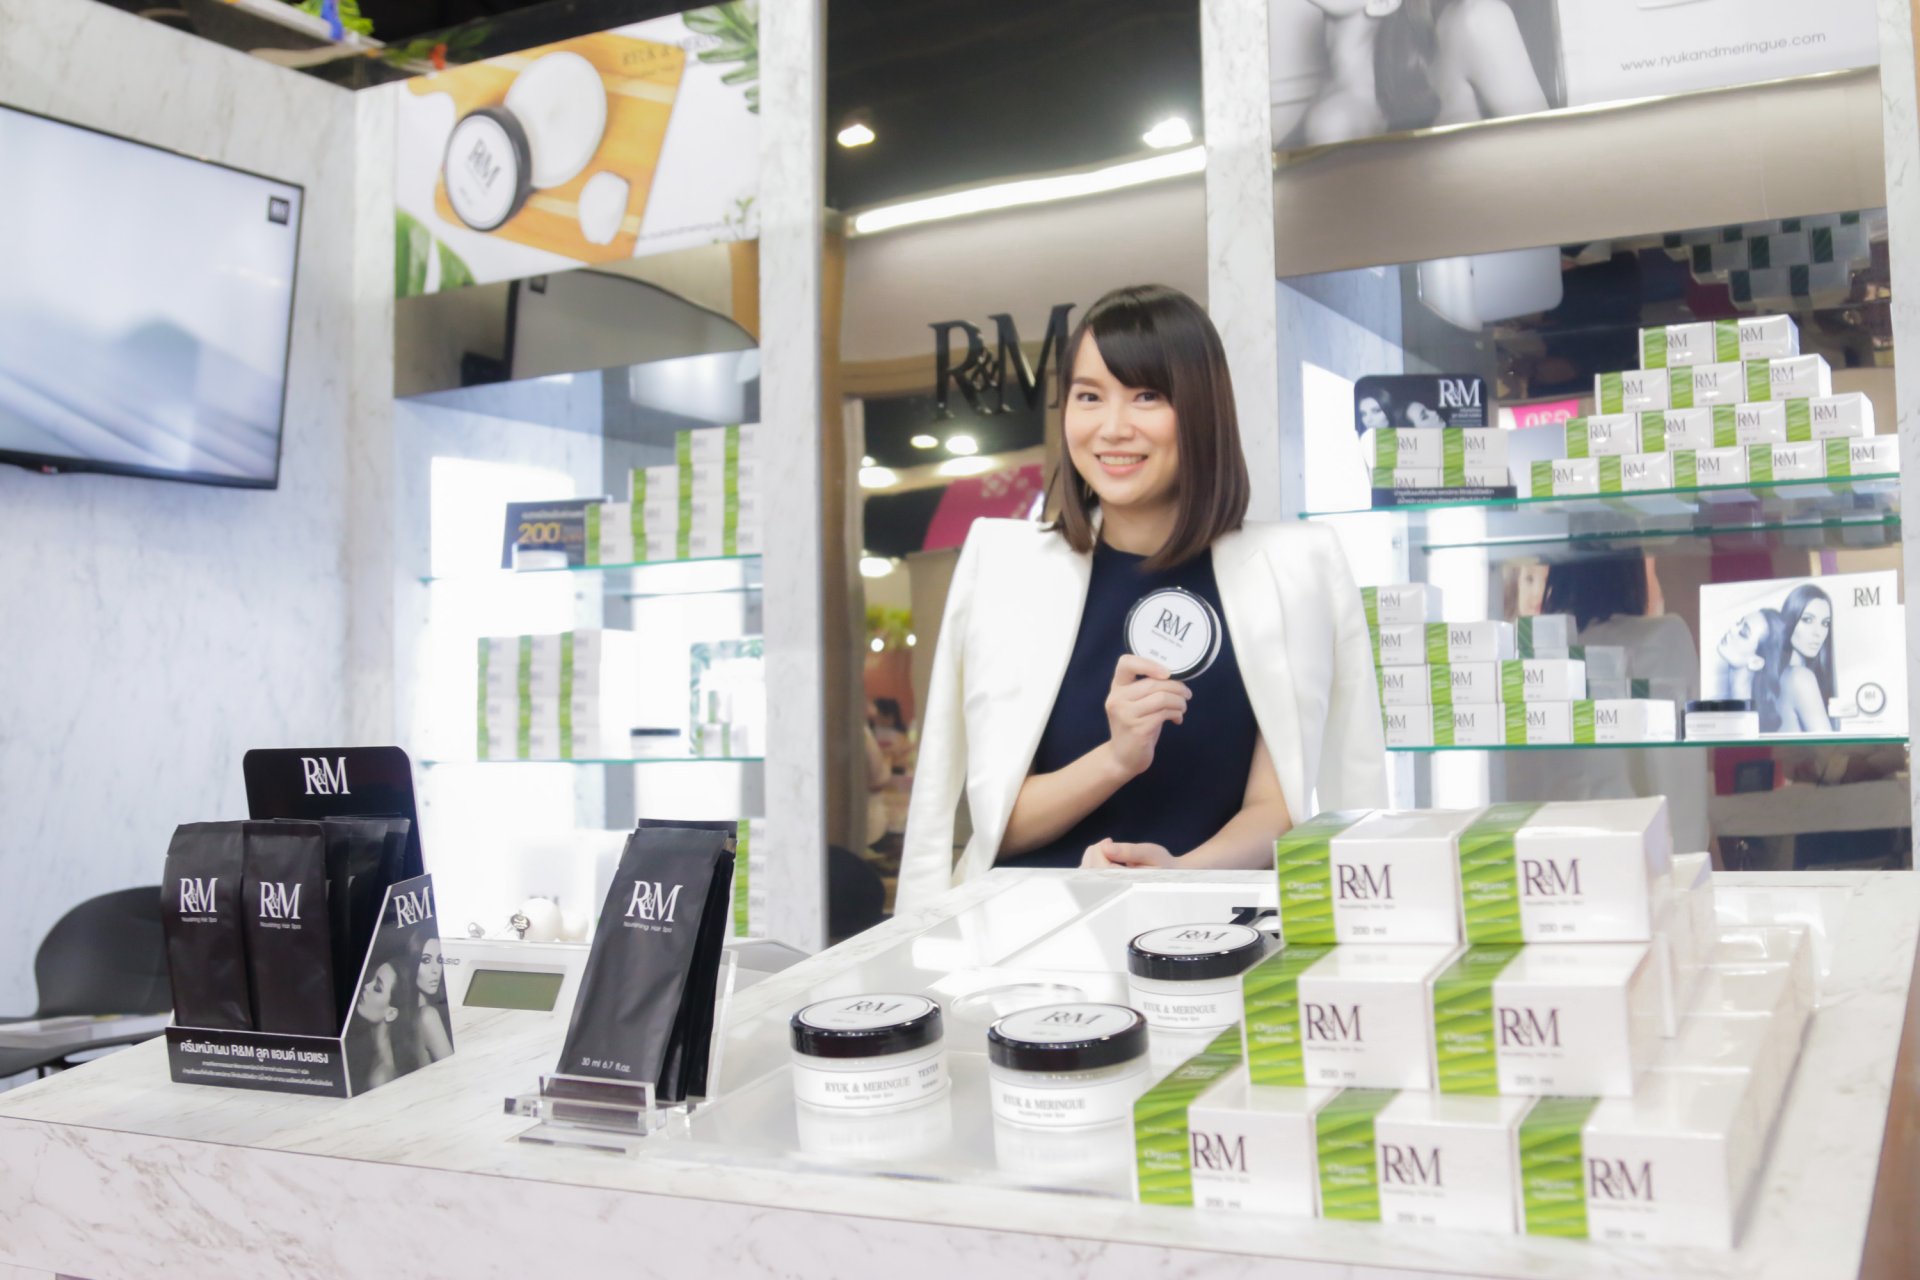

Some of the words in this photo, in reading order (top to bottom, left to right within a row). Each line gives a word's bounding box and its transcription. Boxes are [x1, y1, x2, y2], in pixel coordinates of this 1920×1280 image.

[1620, 32, 1826, 72] www.ryukandmeringue.com
[928, 303, 1076, 416] R&M
[518, 522, 560, 544] 200
[301, 757, 351, 794] R&M
[179, 877, 218, 912] R&M
[1337, 863, 1394, 900] R&M
[1521, 859, 1583, 896] R&M
[259, 882, 302, 919] R&M
[393, 886, 433, 928] R&M
[624, 880, 683, 922] R&M
[1304, 1003, 1363, 1042] R&M
[1498, 1008, 1562, 1048] R&M
[231, 1044, 254, 1058] R&M
[1191, 1132, 1249, 1173] R&M
[1381, 1144, 1444, 1187] R&M
[1588, 1158, 1654, 1202] R&M
